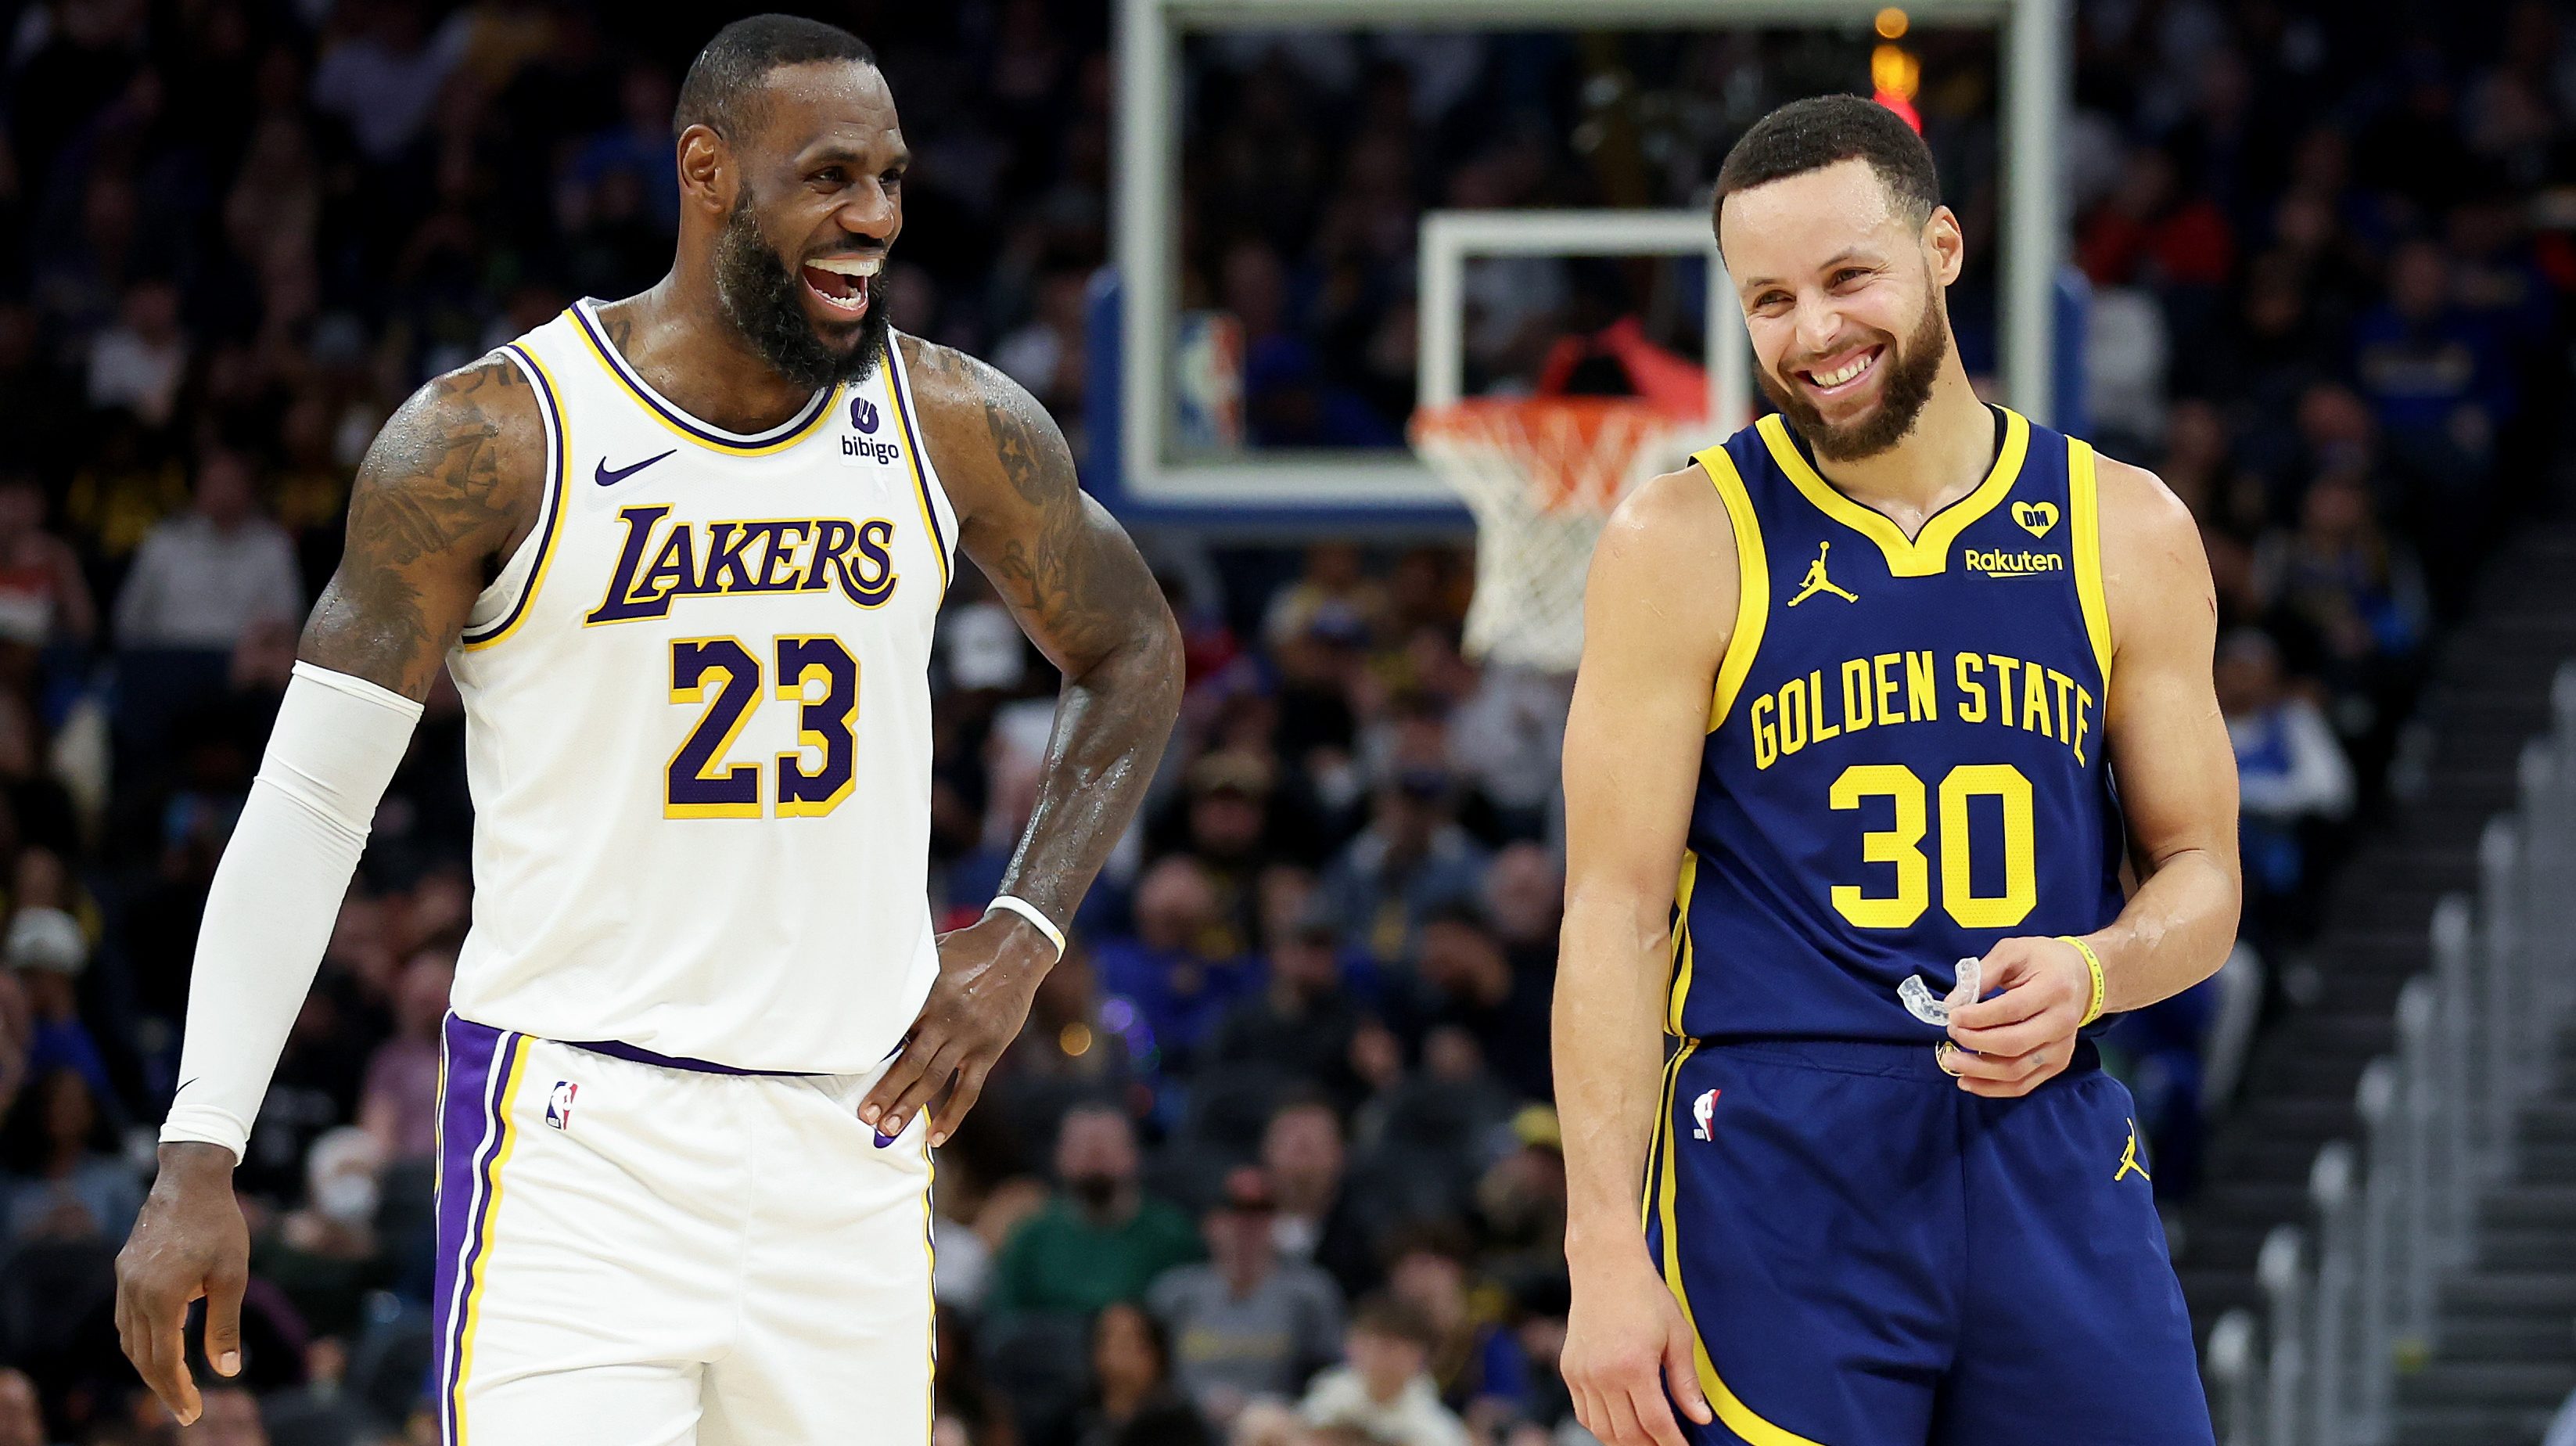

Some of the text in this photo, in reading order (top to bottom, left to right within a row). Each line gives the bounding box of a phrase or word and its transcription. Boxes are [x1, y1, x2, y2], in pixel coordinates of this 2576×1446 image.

[842, 435, 899, 464] bibigo
[583, 502, 899, 628] LAKERS
[1965, 549, 2063, 571] Rakuten
[2022, 510, 2050, 527] DM
[663, 634, 861, 819] 23
[1751, 650, 2093, 772] GOLDEN STATE
[1829, 764, 2038, 929] 30
